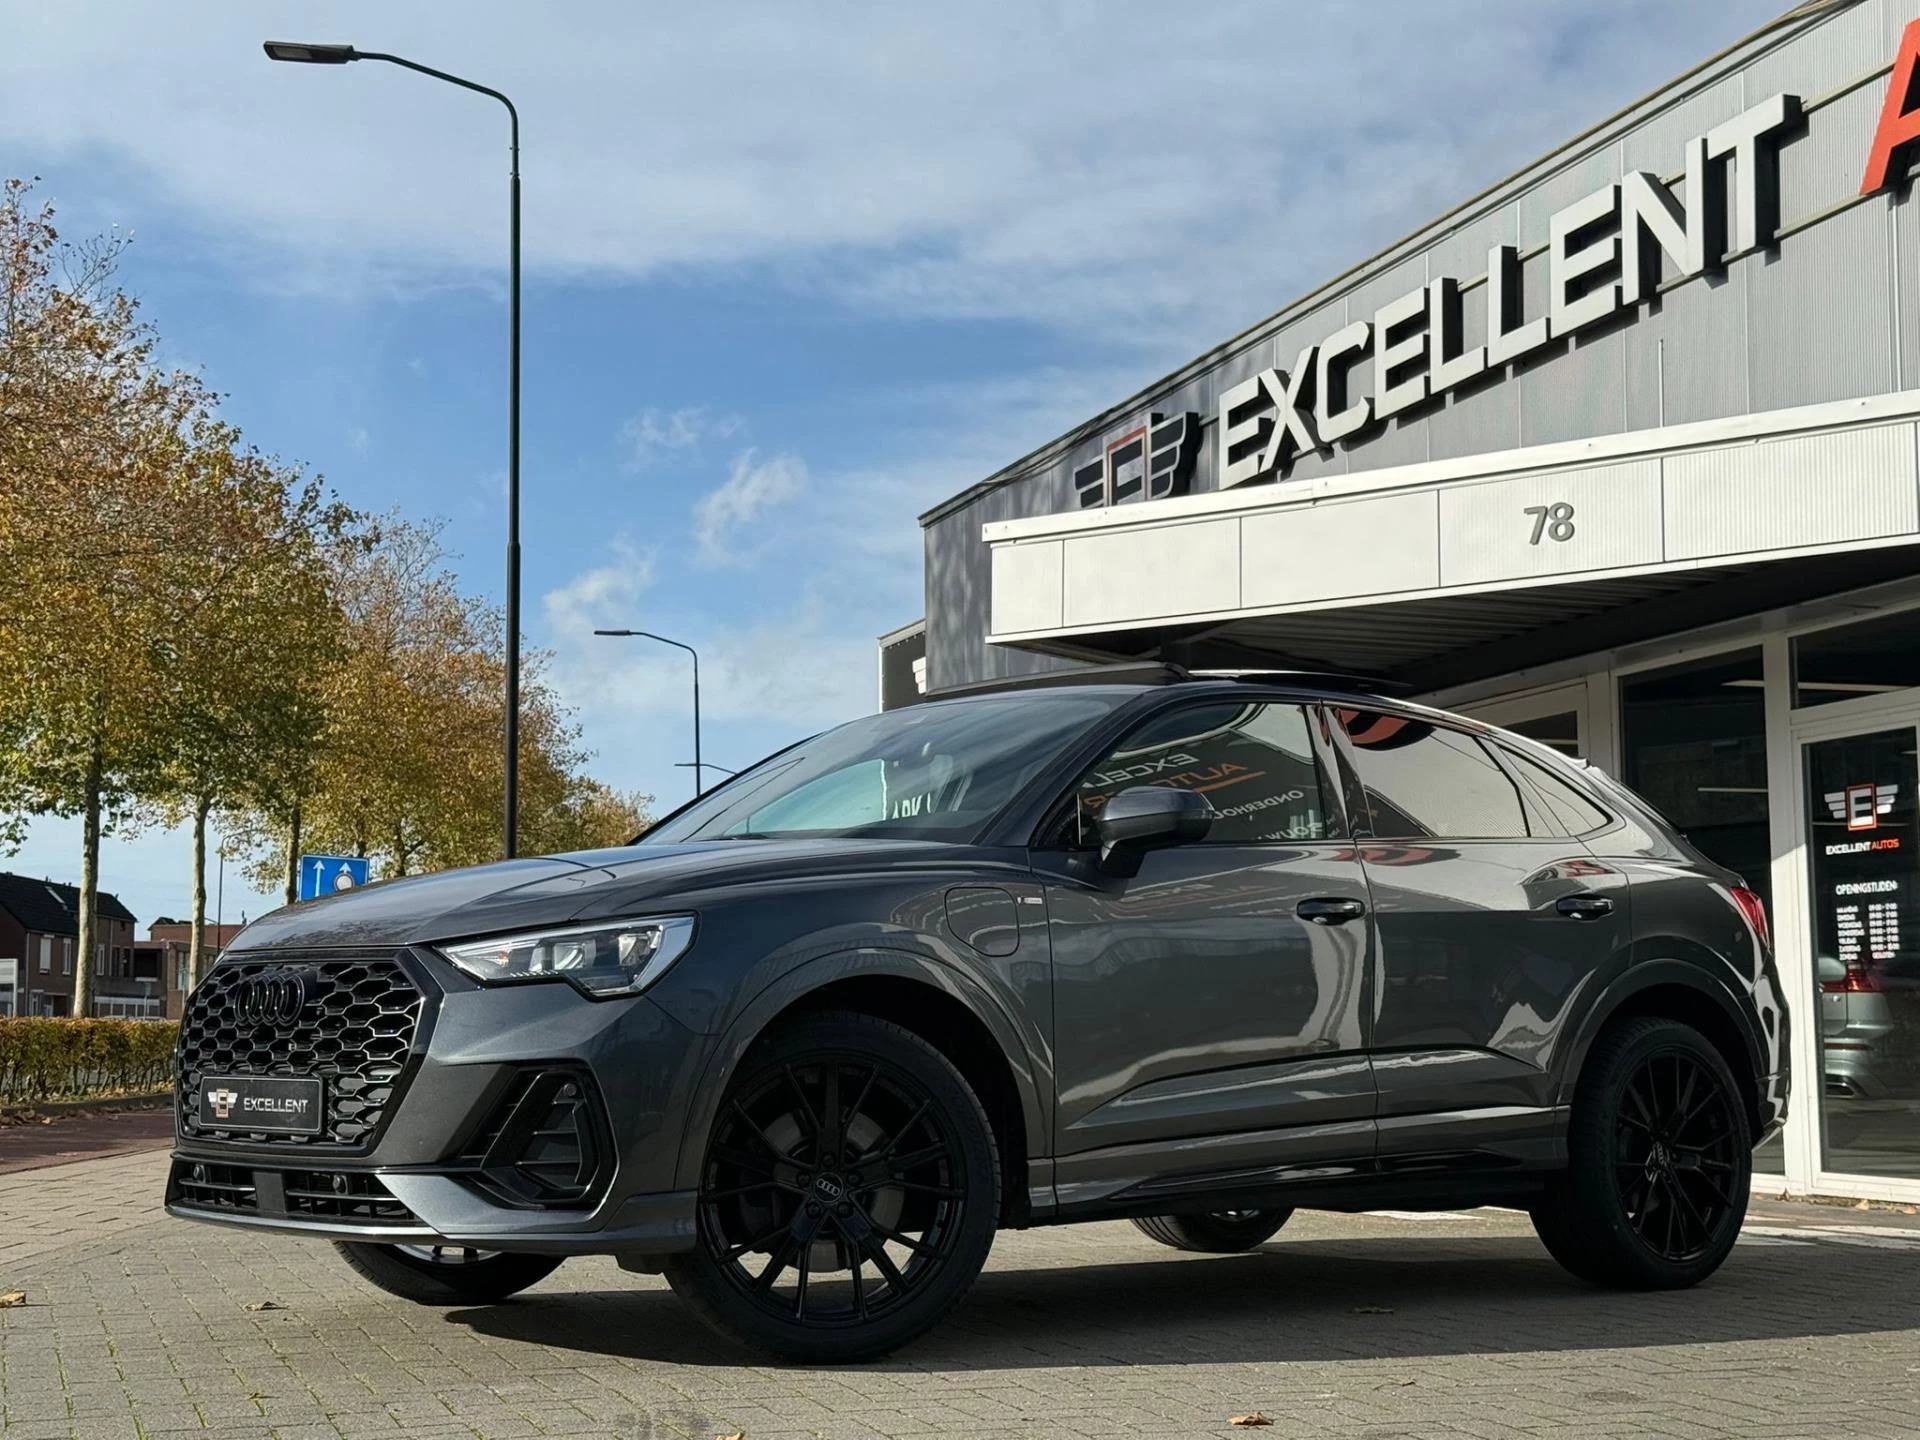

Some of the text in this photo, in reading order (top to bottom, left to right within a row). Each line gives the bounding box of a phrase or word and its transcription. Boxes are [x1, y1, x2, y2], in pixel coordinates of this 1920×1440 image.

[1218, 93, 1798, 490] EXCELLENT
[1524, 502, 1574, 546] 78
[1825, 838, 1900, 855] EXCELLENT AUTOS
[243, 1097, 308, 1114] EXCELLENT
